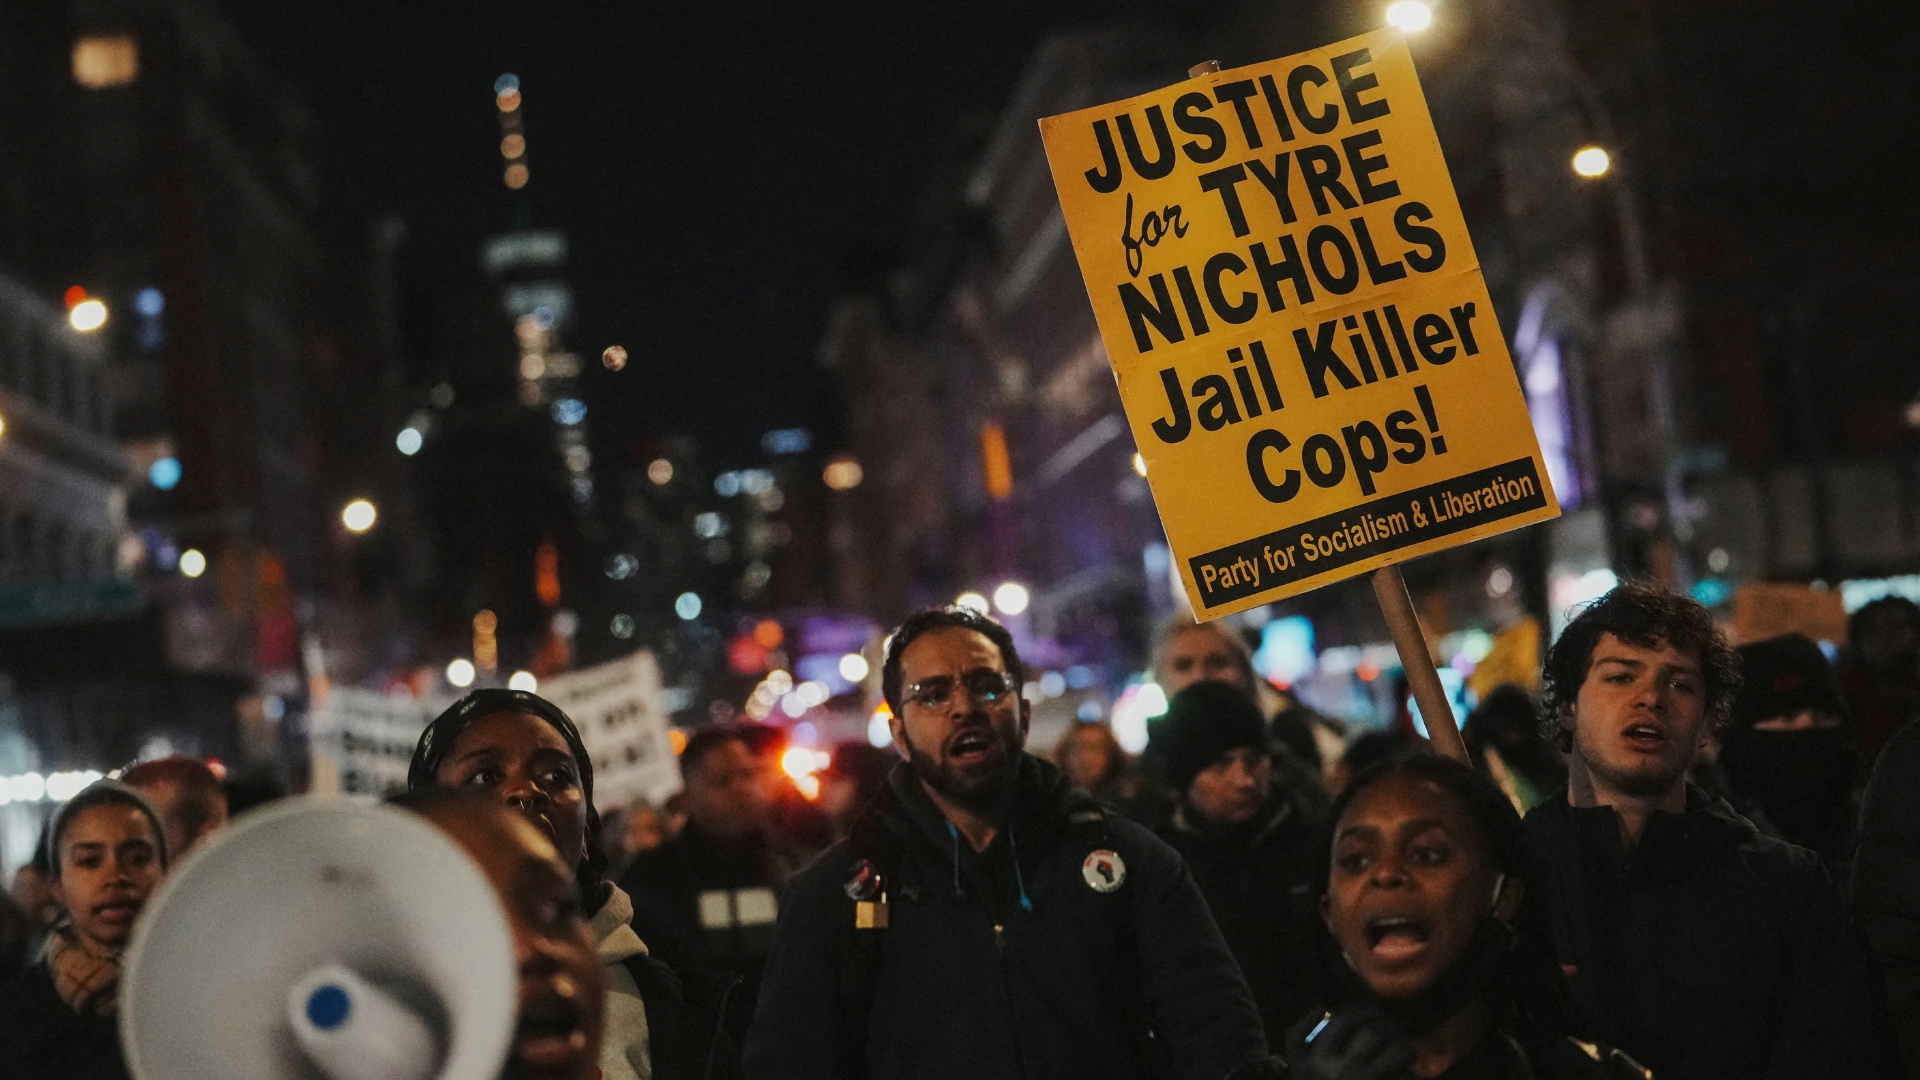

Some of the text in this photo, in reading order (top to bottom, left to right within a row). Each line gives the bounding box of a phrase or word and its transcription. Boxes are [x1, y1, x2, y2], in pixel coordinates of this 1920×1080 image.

[1083, 48, 1391, 194] JUSTICE
[1121, 128, 1402, 279] for TYRE
[1116, 201, 1447, 354] NICHOLS
[1151, 301, 1480, 444] Jail Killer
[1245, 383, 1449, 504] Cops!
[1200, 475, 1535, 593] Party for Socialism & Liberation
